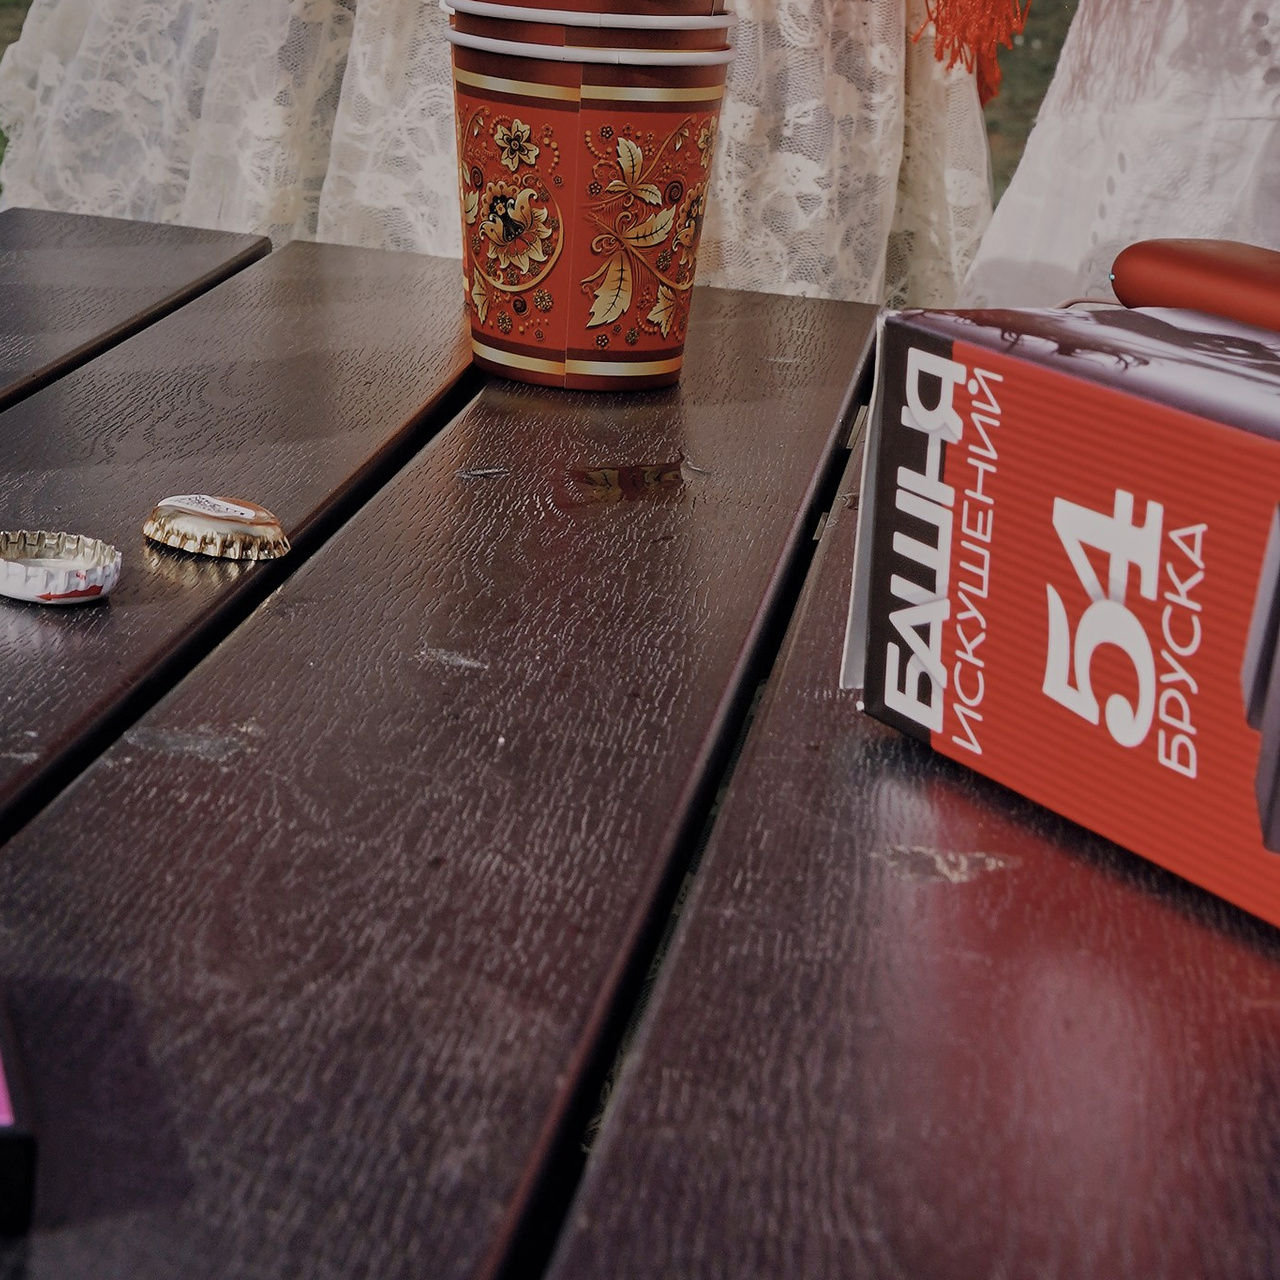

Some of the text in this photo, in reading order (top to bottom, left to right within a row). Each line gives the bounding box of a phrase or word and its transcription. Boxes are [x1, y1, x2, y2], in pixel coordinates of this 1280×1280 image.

[884, 346, 969, 735] БАШНЯ
[951, 367, 1004, 755] ИСКУШЕНИЙ
[1042, 488, 1165, 749] 54
[1158, 523, 1209, 779] БРУСКА
